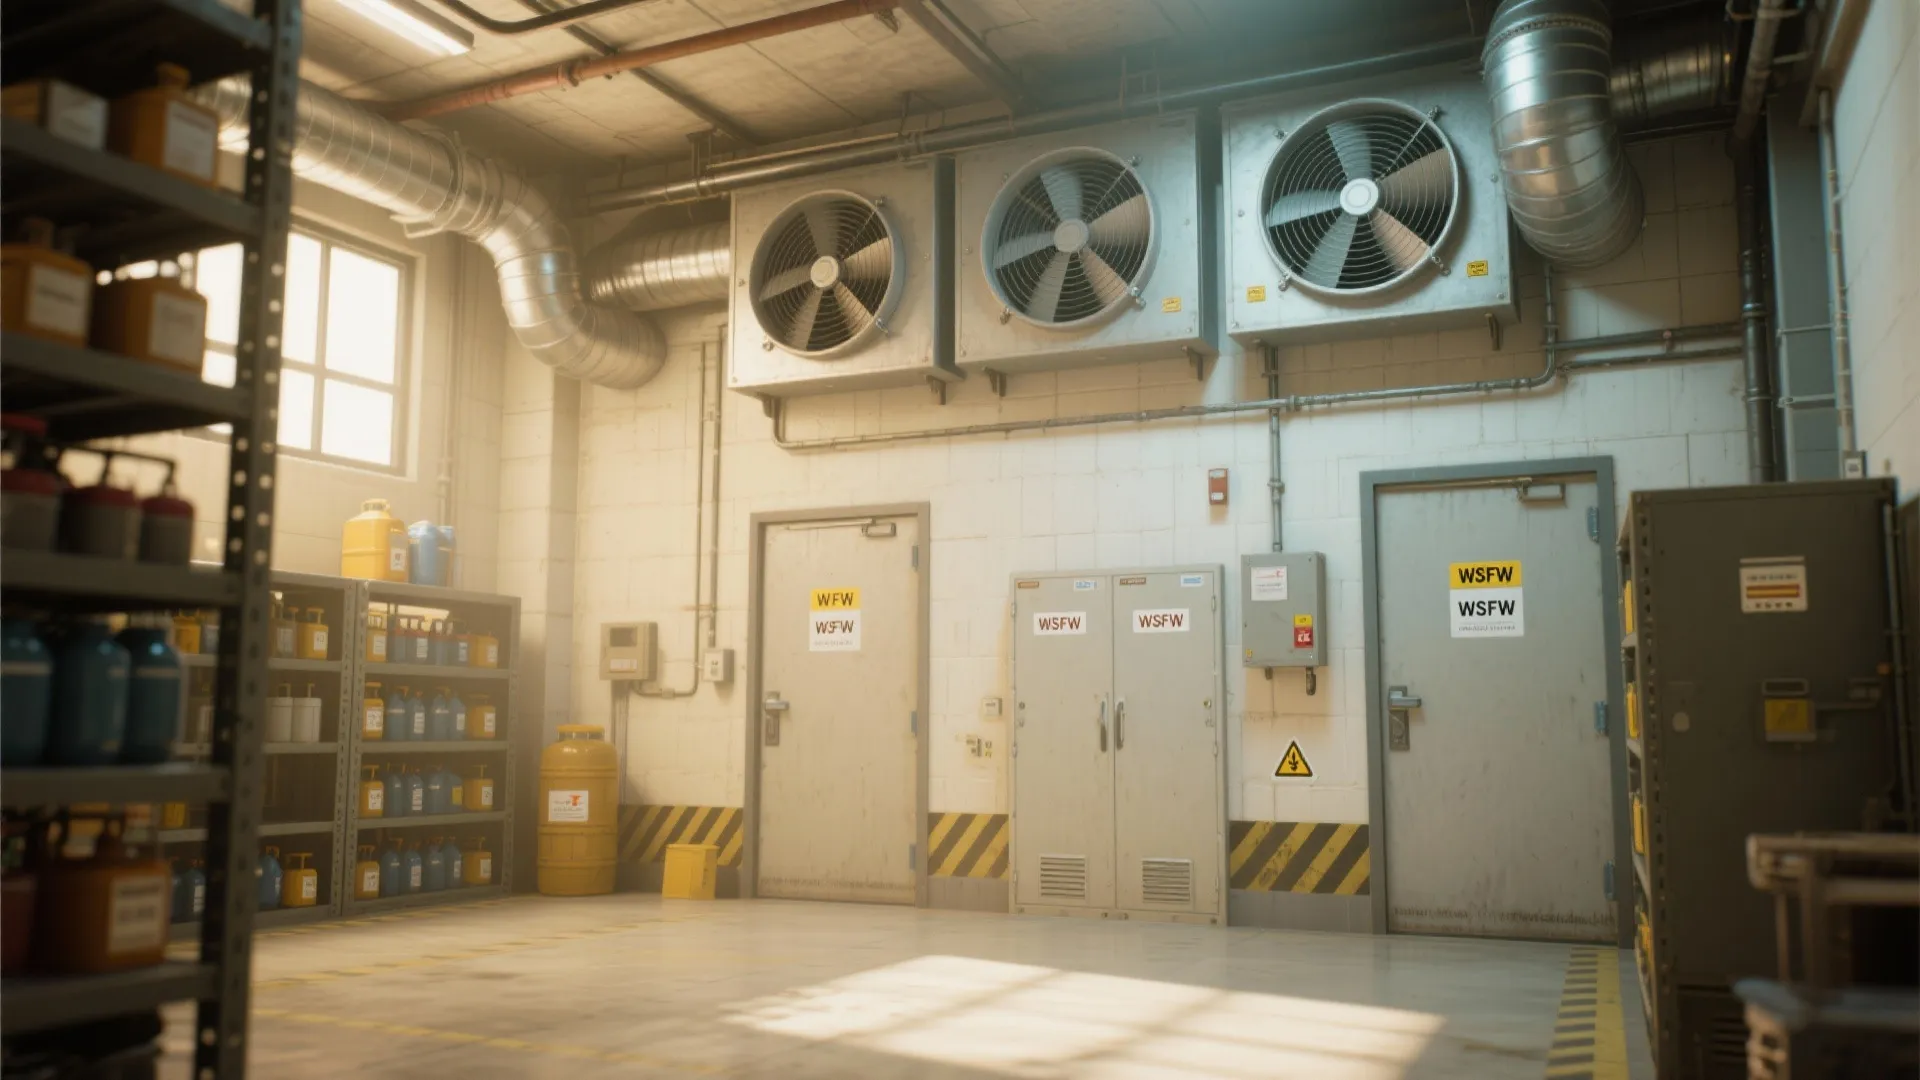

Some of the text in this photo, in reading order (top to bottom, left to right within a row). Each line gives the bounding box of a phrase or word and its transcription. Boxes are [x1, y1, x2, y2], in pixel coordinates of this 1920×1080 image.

[1458, 566, 1514, 584] WSFW
[817, 592, 854, 607] WFW
[1458, 600, 1516, 617] WSFW
[1038, 616, 1081, 631] WSFW
[1138, 613, 1184, 628] WSFW
